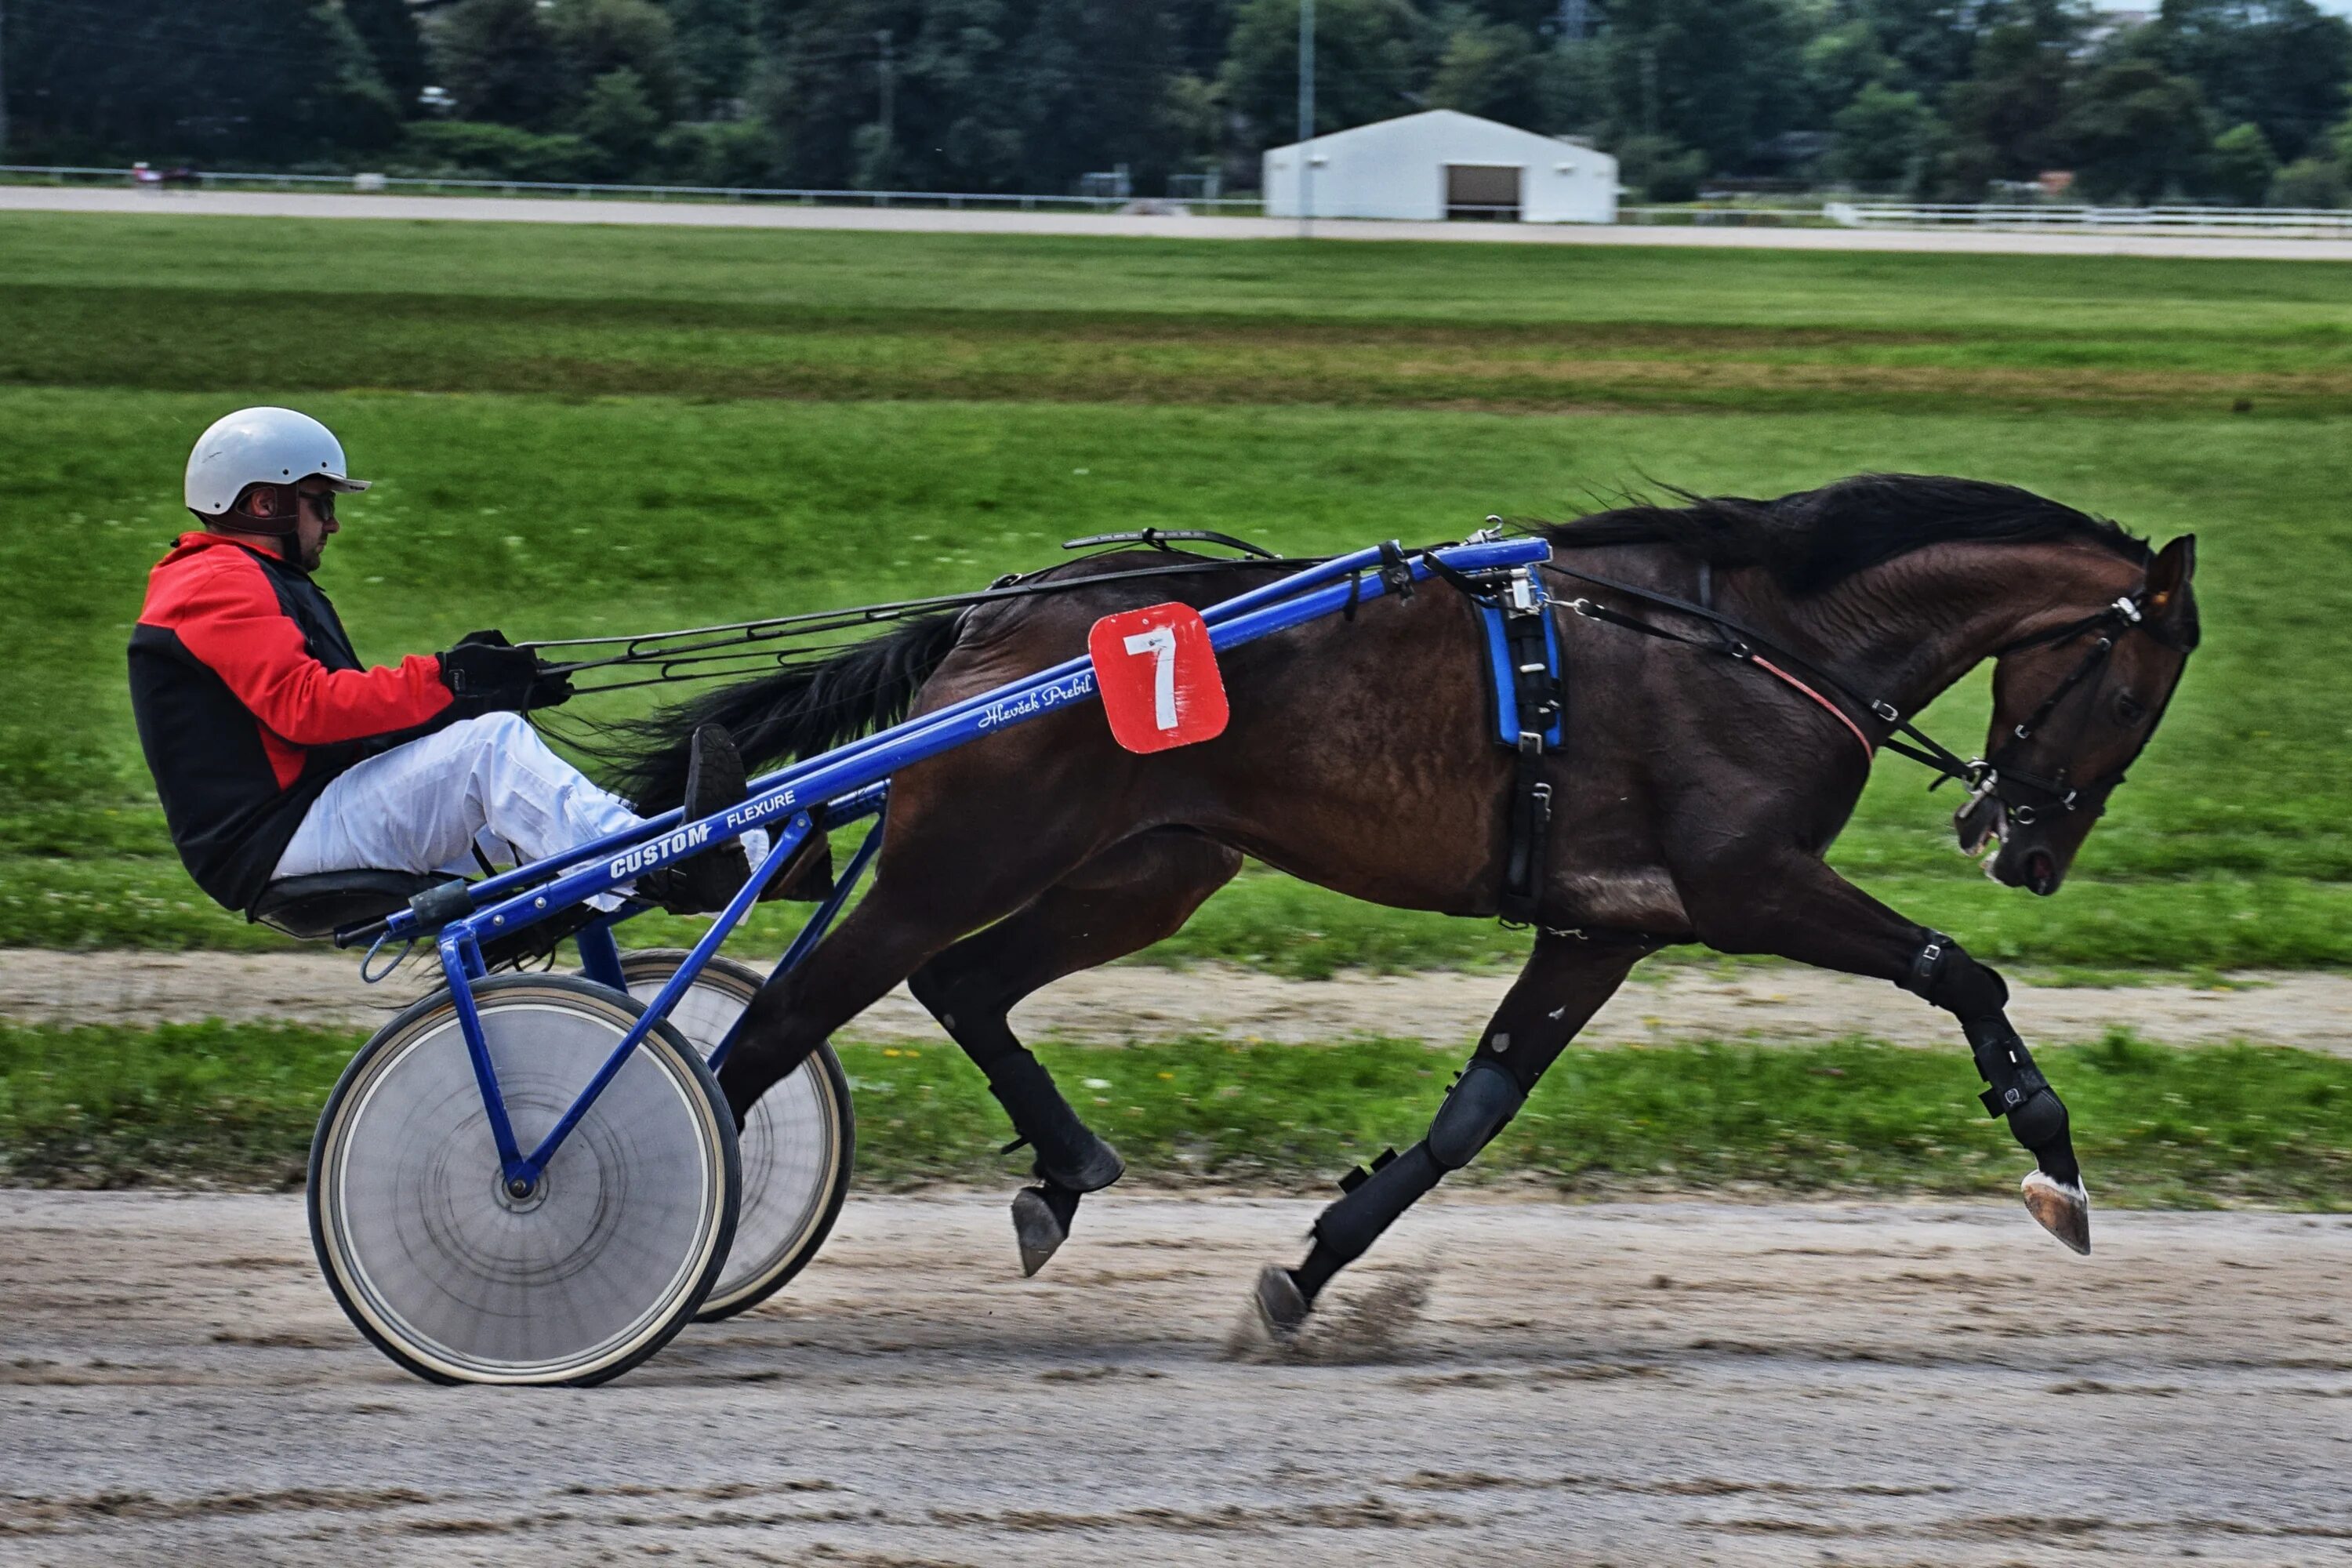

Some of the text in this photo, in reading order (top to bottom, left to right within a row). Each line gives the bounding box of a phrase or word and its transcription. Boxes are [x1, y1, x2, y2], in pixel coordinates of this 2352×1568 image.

[1042, 674, 1093, 706] Prebil
[1123, 627, 1178, 731] 7
[610, 790, 796, 879] CUSTOM FLEXURE
